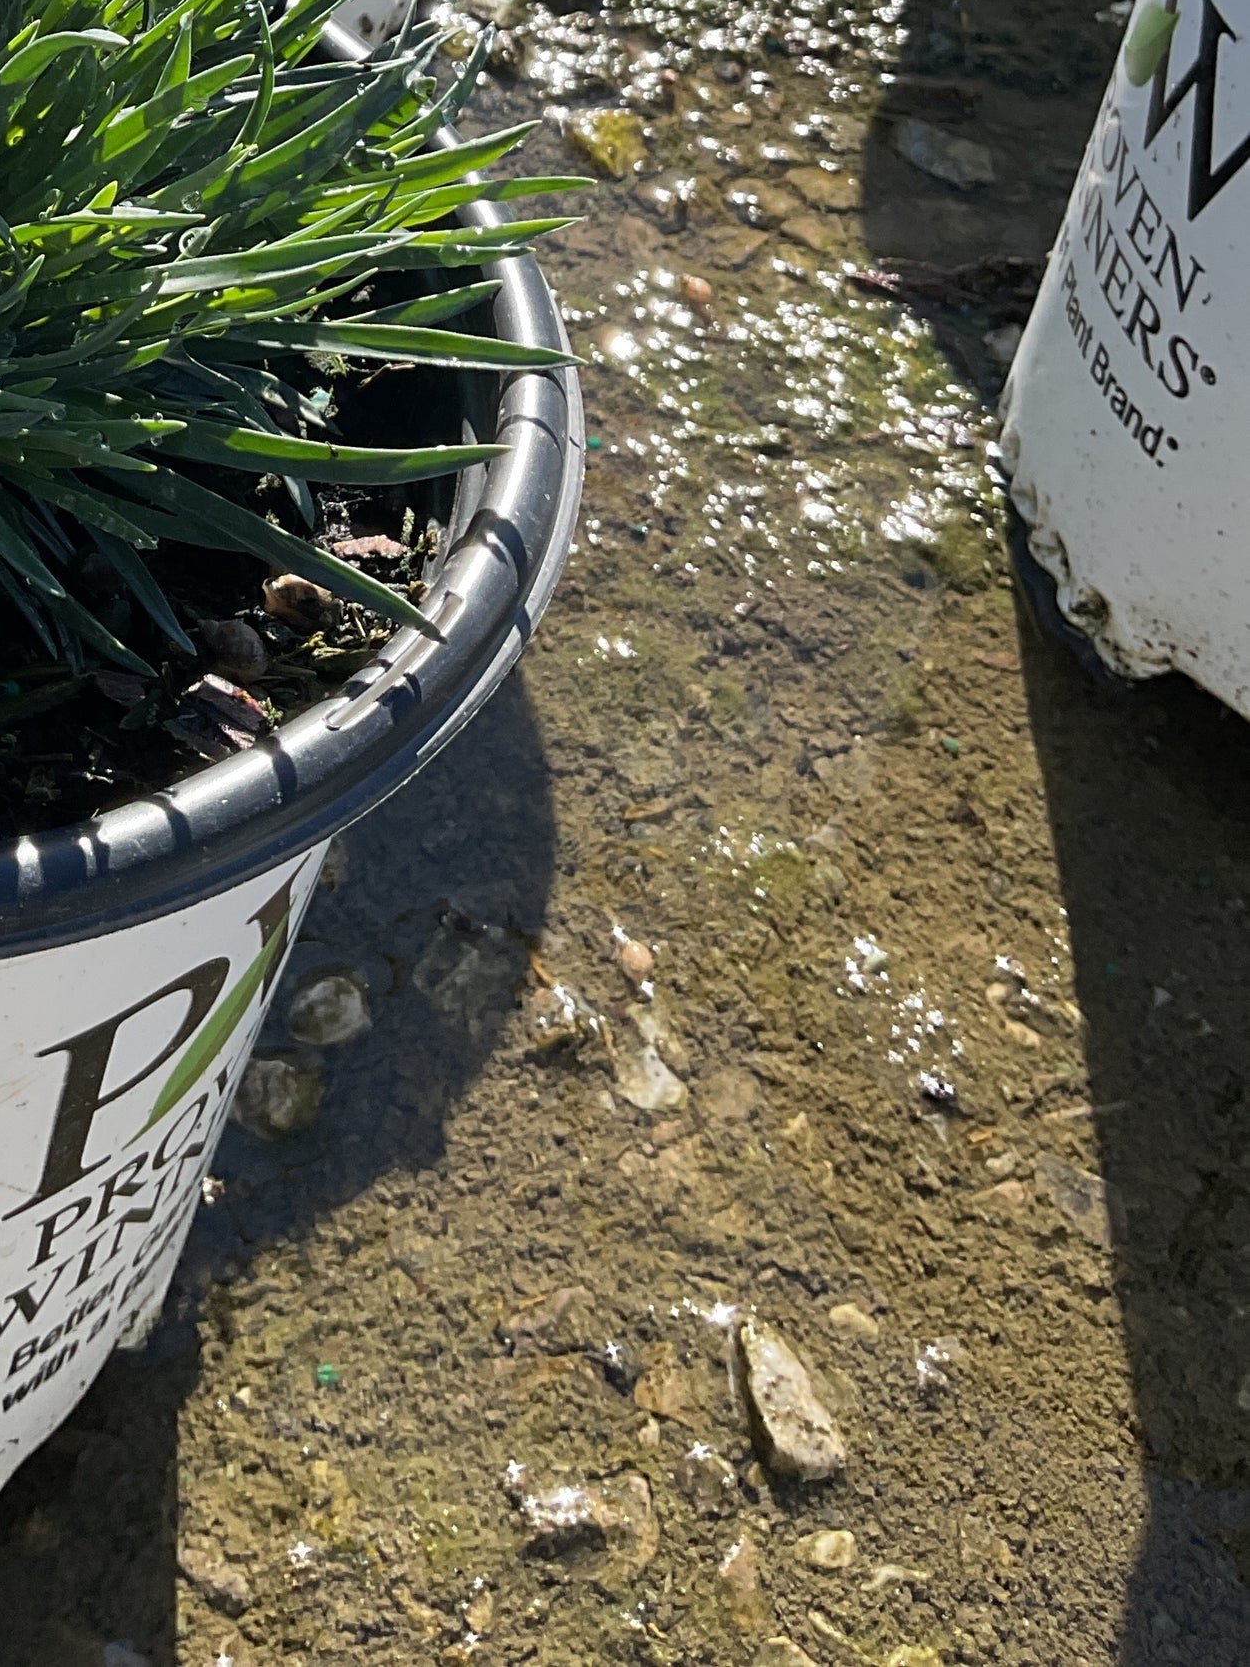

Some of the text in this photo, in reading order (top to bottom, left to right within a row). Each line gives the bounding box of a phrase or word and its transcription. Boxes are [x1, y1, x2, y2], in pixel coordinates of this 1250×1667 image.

[1102, 104, 1205, 313] OVEN
[1060, 255, 1094, 360] Plant
[1, 1338, 80, 1414] with
[6, 1263, 127, 1383] Better
